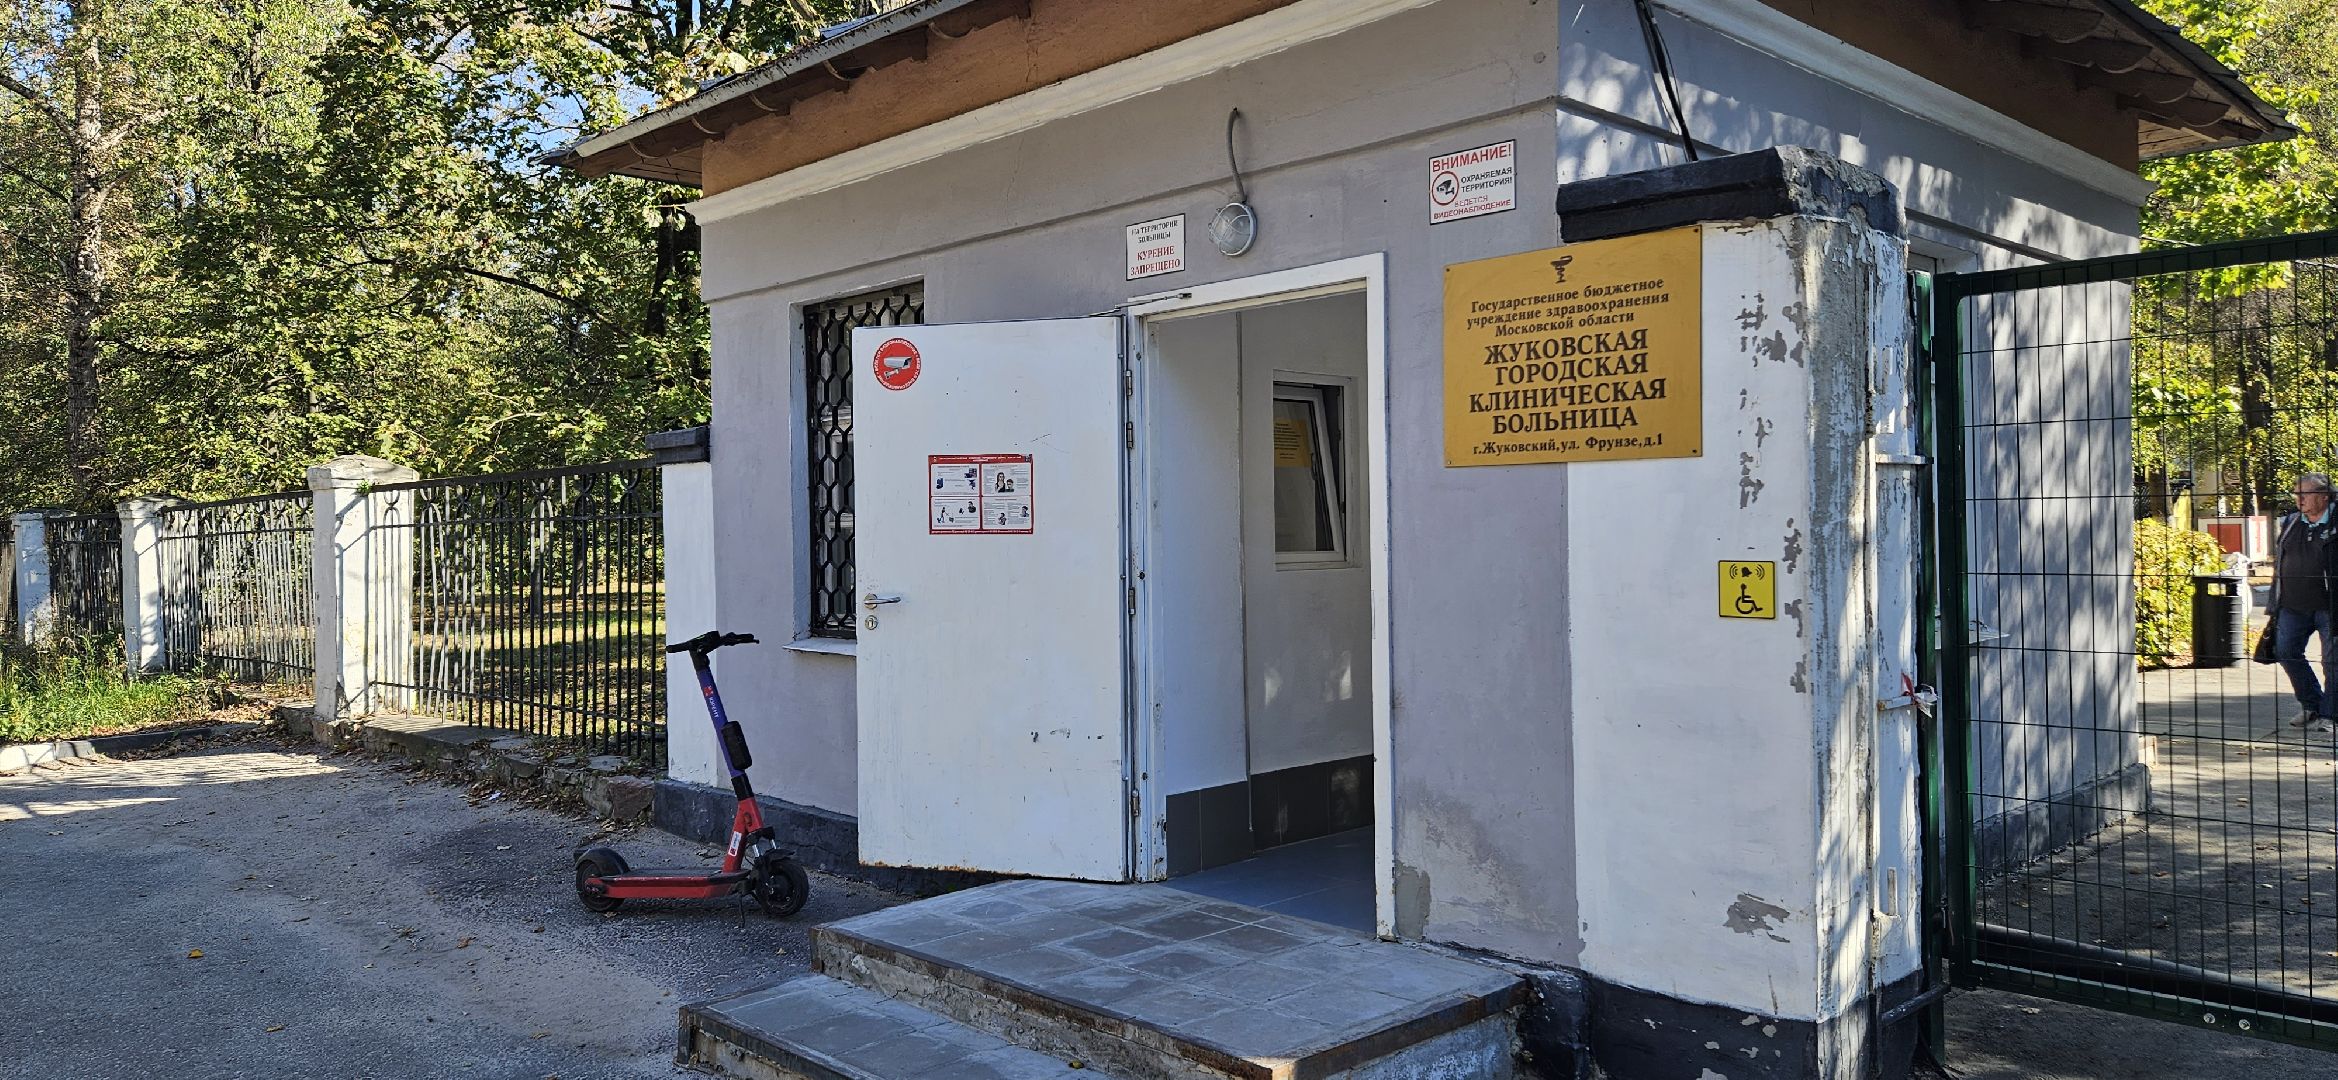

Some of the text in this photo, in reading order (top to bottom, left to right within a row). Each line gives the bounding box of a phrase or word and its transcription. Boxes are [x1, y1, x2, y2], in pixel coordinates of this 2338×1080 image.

[1432, 144, 1512, 172] ВНИМАНИЕ!
[1461, 167, 1512, 184] ОХРАНЯЕМАЯ
[1461, 177, 1512, 193] ТЕРРИТОРИЯ!
[1433, 199, 1511, 219] ВИДЕОНАБЛЮДЕНИЕ
[1138, 231, 1171, 243] БОЛЬНИЦЫ
[1137, 246, 1175, 261] КУРЕНИЕ
[1130, 259, 1180, 276] ЗАПРЕЩЕНО
[1471, 278, 1664, 314] Государственное бюджетное
[1467, 293, 1670, 330] учреждение здравоохранения
[1495, 311, 1634, 337] Московской области
[1484, 329, 1649, 365] ЖУКОВСКАЯ
[1495, 352, 1648, 386] ГОРОДСКАЯ
[1469, 378, 1667, 413] КЛИНИЧЕСКАЯ
[1492, 406, 1639, 435] БОЛЬНИЦА
[1585, 433, 1663, 452] Фрунзе,д.1
